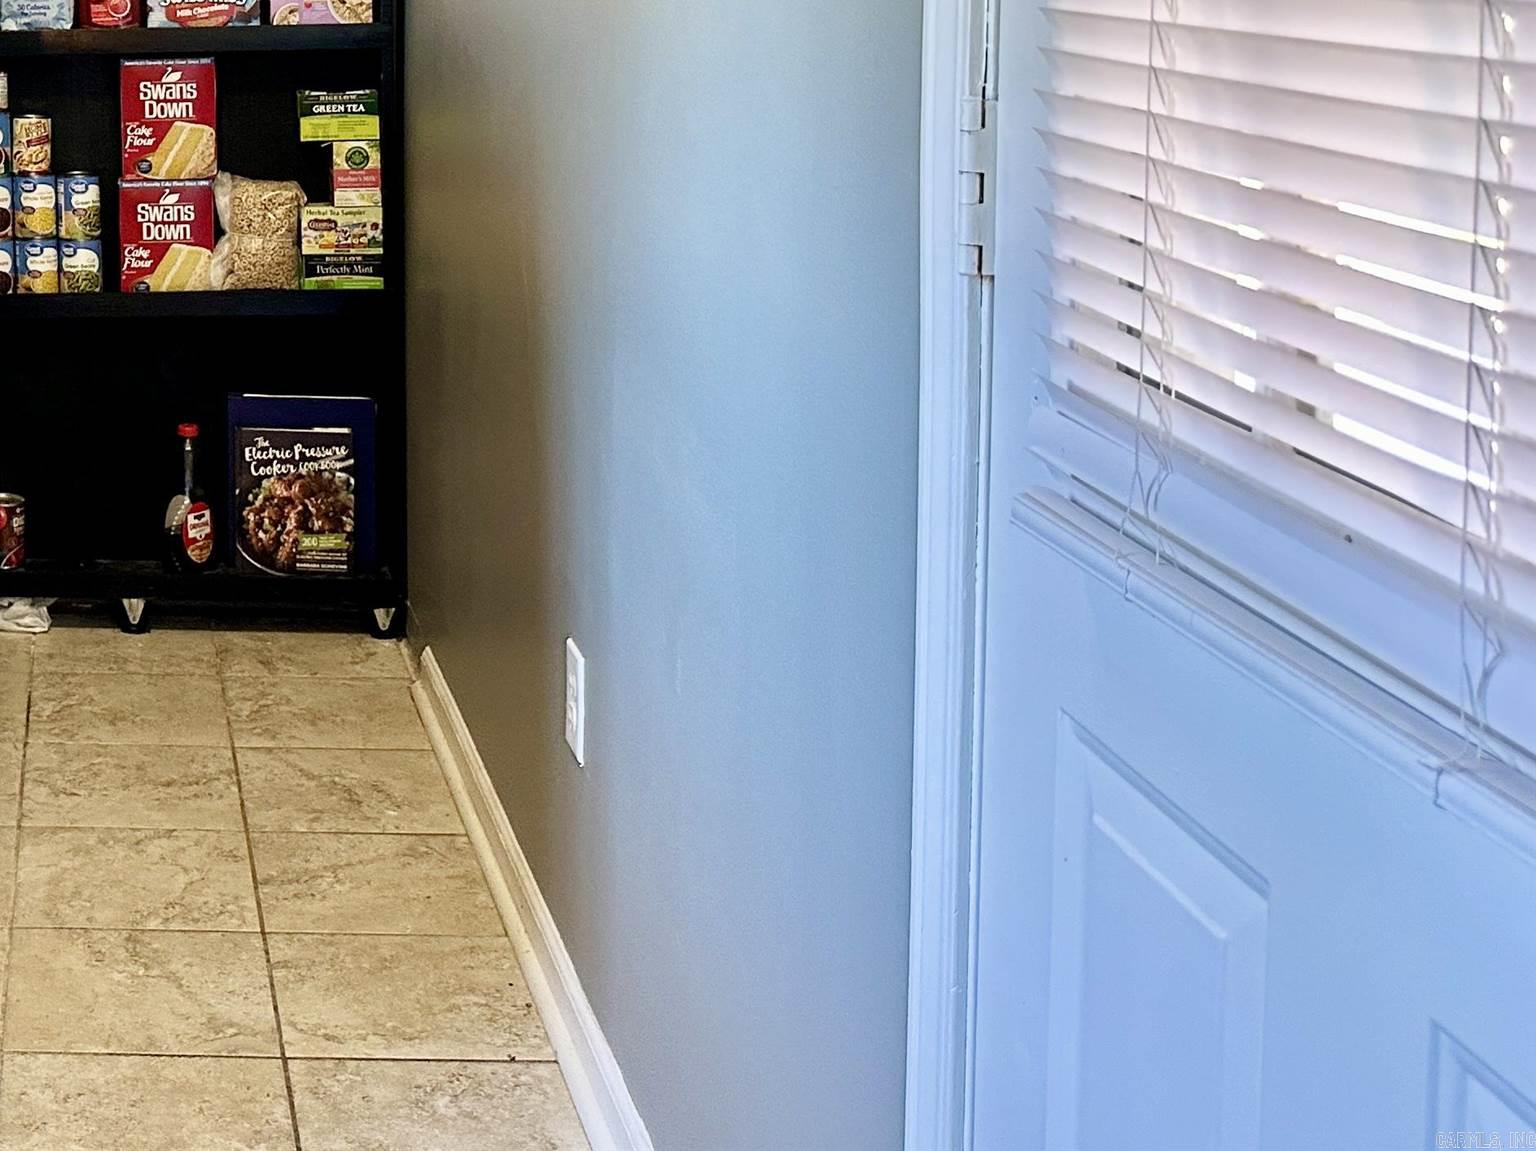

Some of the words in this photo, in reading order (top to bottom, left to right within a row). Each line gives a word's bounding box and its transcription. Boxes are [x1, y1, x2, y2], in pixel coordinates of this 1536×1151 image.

[139, 81, 198, 100] Swans
[145, 100, 193, 119] Down
[312, 104, 344, 113] GREEN
[345, 103, 366, 112] TEA
[126, 124, 154, 137] Cake
[125, 136, 156, 149] Flour
[137, 203, 195, 222] Swans
[142, 222, 191, 240] Down
[124, 246, 151, 259] Cake
[122, 257, 153, 271] Flour
[316, 264, 351, 274] Perfectly
[352, 264, 373, 274] Mint
[254, 436, 270, 448] The
[244, 446, 294, 462] Electric
[293, 443, 349, 460] Pressure
[250, 460, 297, 476] Cooker
